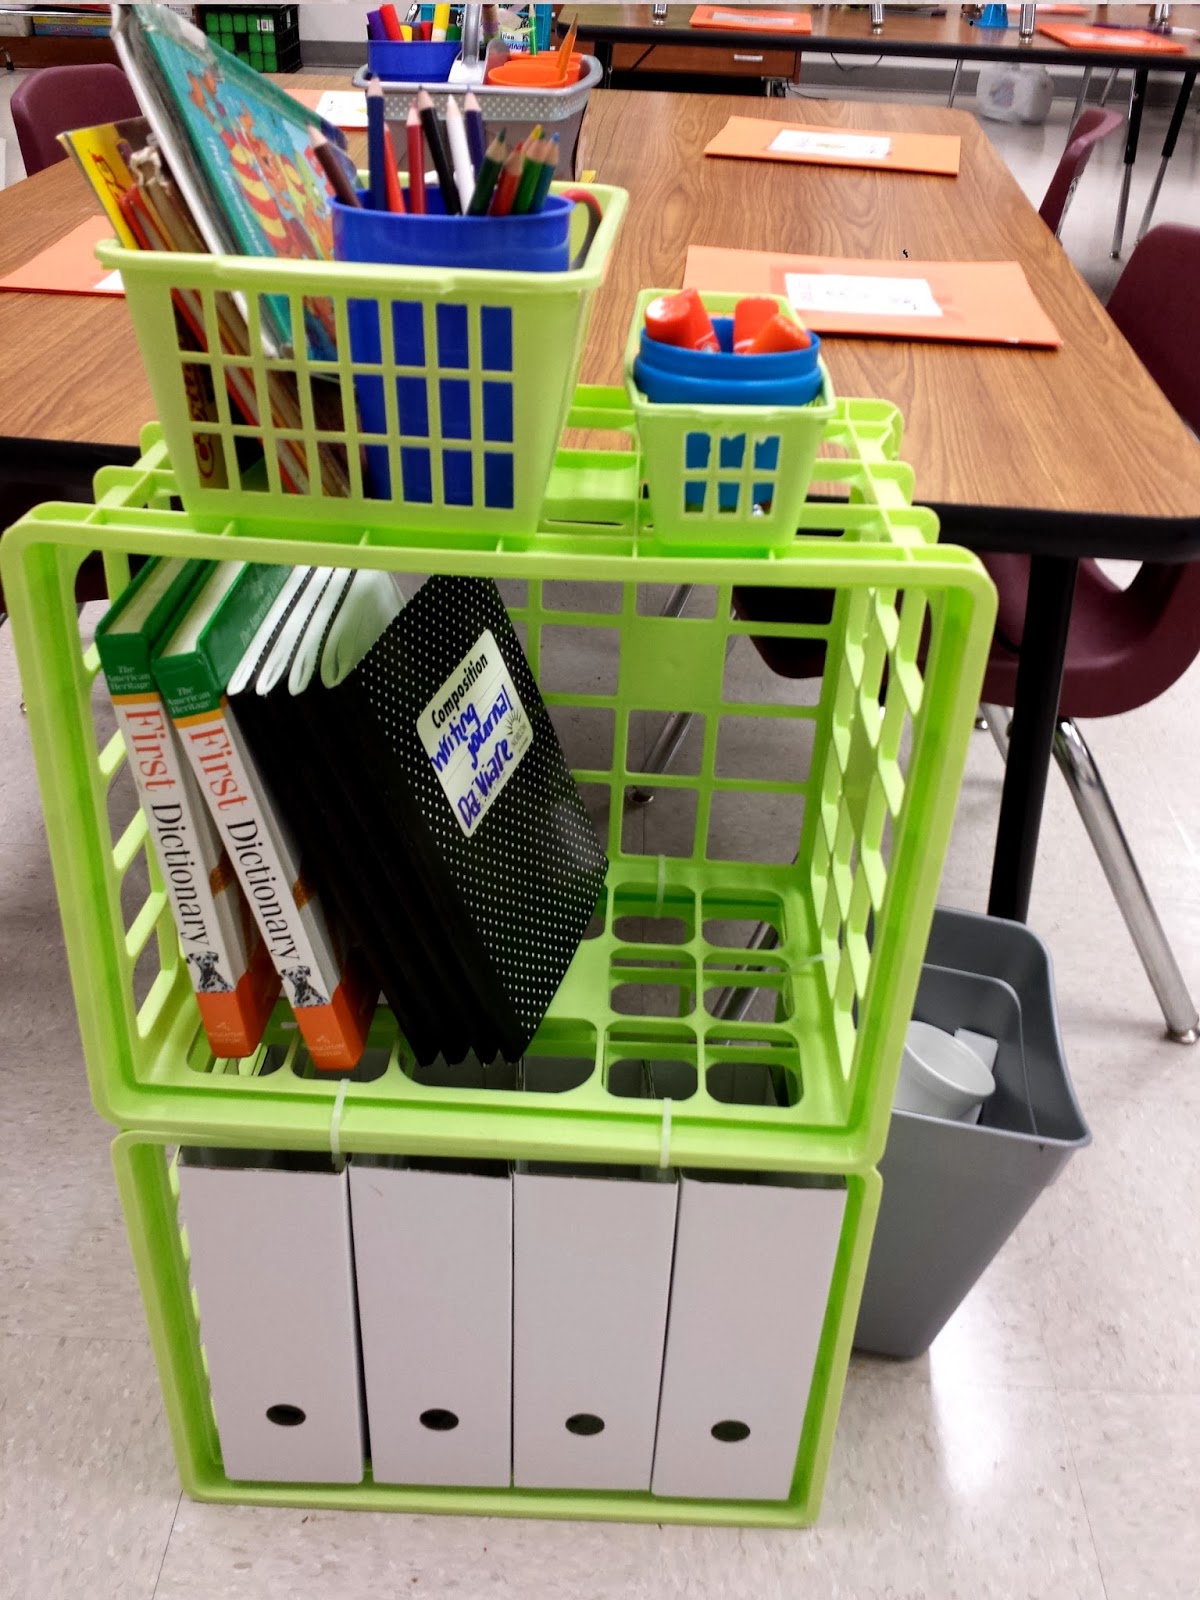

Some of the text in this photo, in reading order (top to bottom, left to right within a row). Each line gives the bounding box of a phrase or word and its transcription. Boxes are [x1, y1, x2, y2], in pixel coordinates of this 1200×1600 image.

[118, 666, 135, 674] The
[107, 673, 150, 682] American
[110, 682, 150, 690] Heritage
[176, 686, 193, 696] The
[431, 653, 488, 729] Composition
[167, 691, 210, 706] American
[171, 700, 211, 714] Heritage
[125, 709, 210, 946] First Dictionary
[188, 726, 248, 812] First
[226, 818, 301, 960] Dictionary
